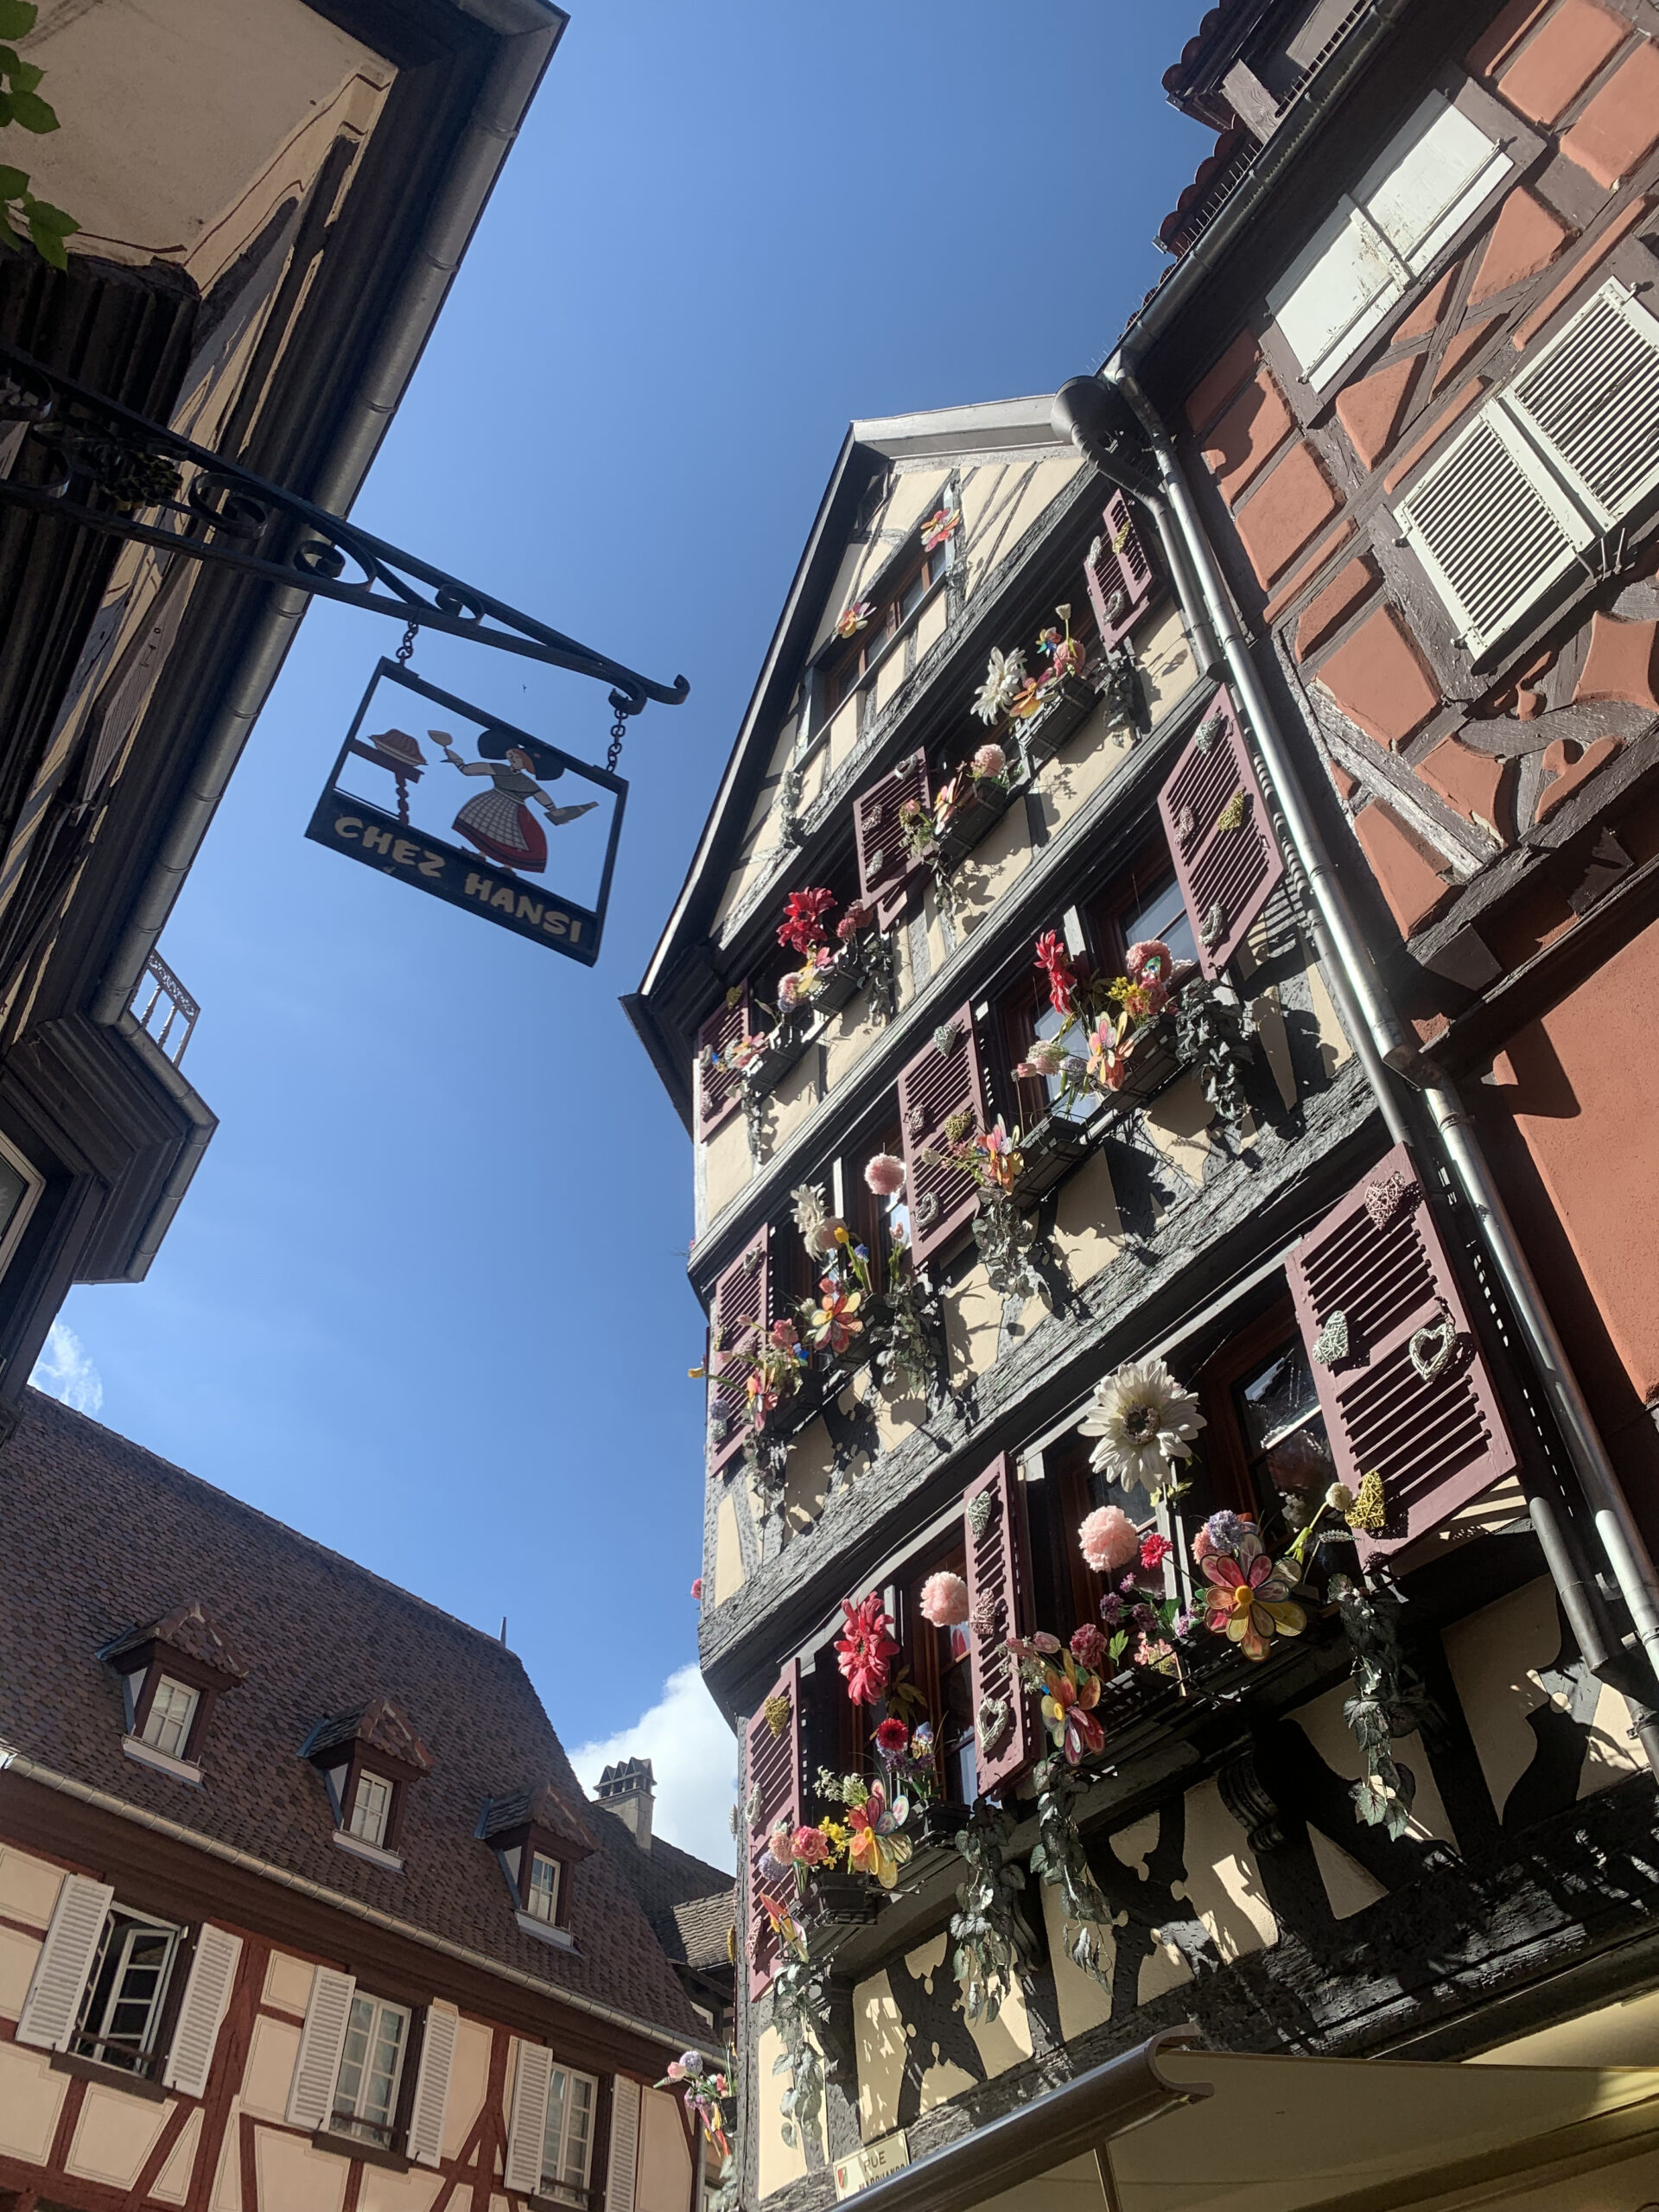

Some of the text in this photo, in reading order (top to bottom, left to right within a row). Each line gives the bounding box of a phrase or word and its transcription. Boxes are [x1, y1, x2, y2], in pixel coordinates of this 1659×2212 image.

[334, 817, 582, 943] CHEZ HANSI
[864, 2151, 887, 2172] RUE
